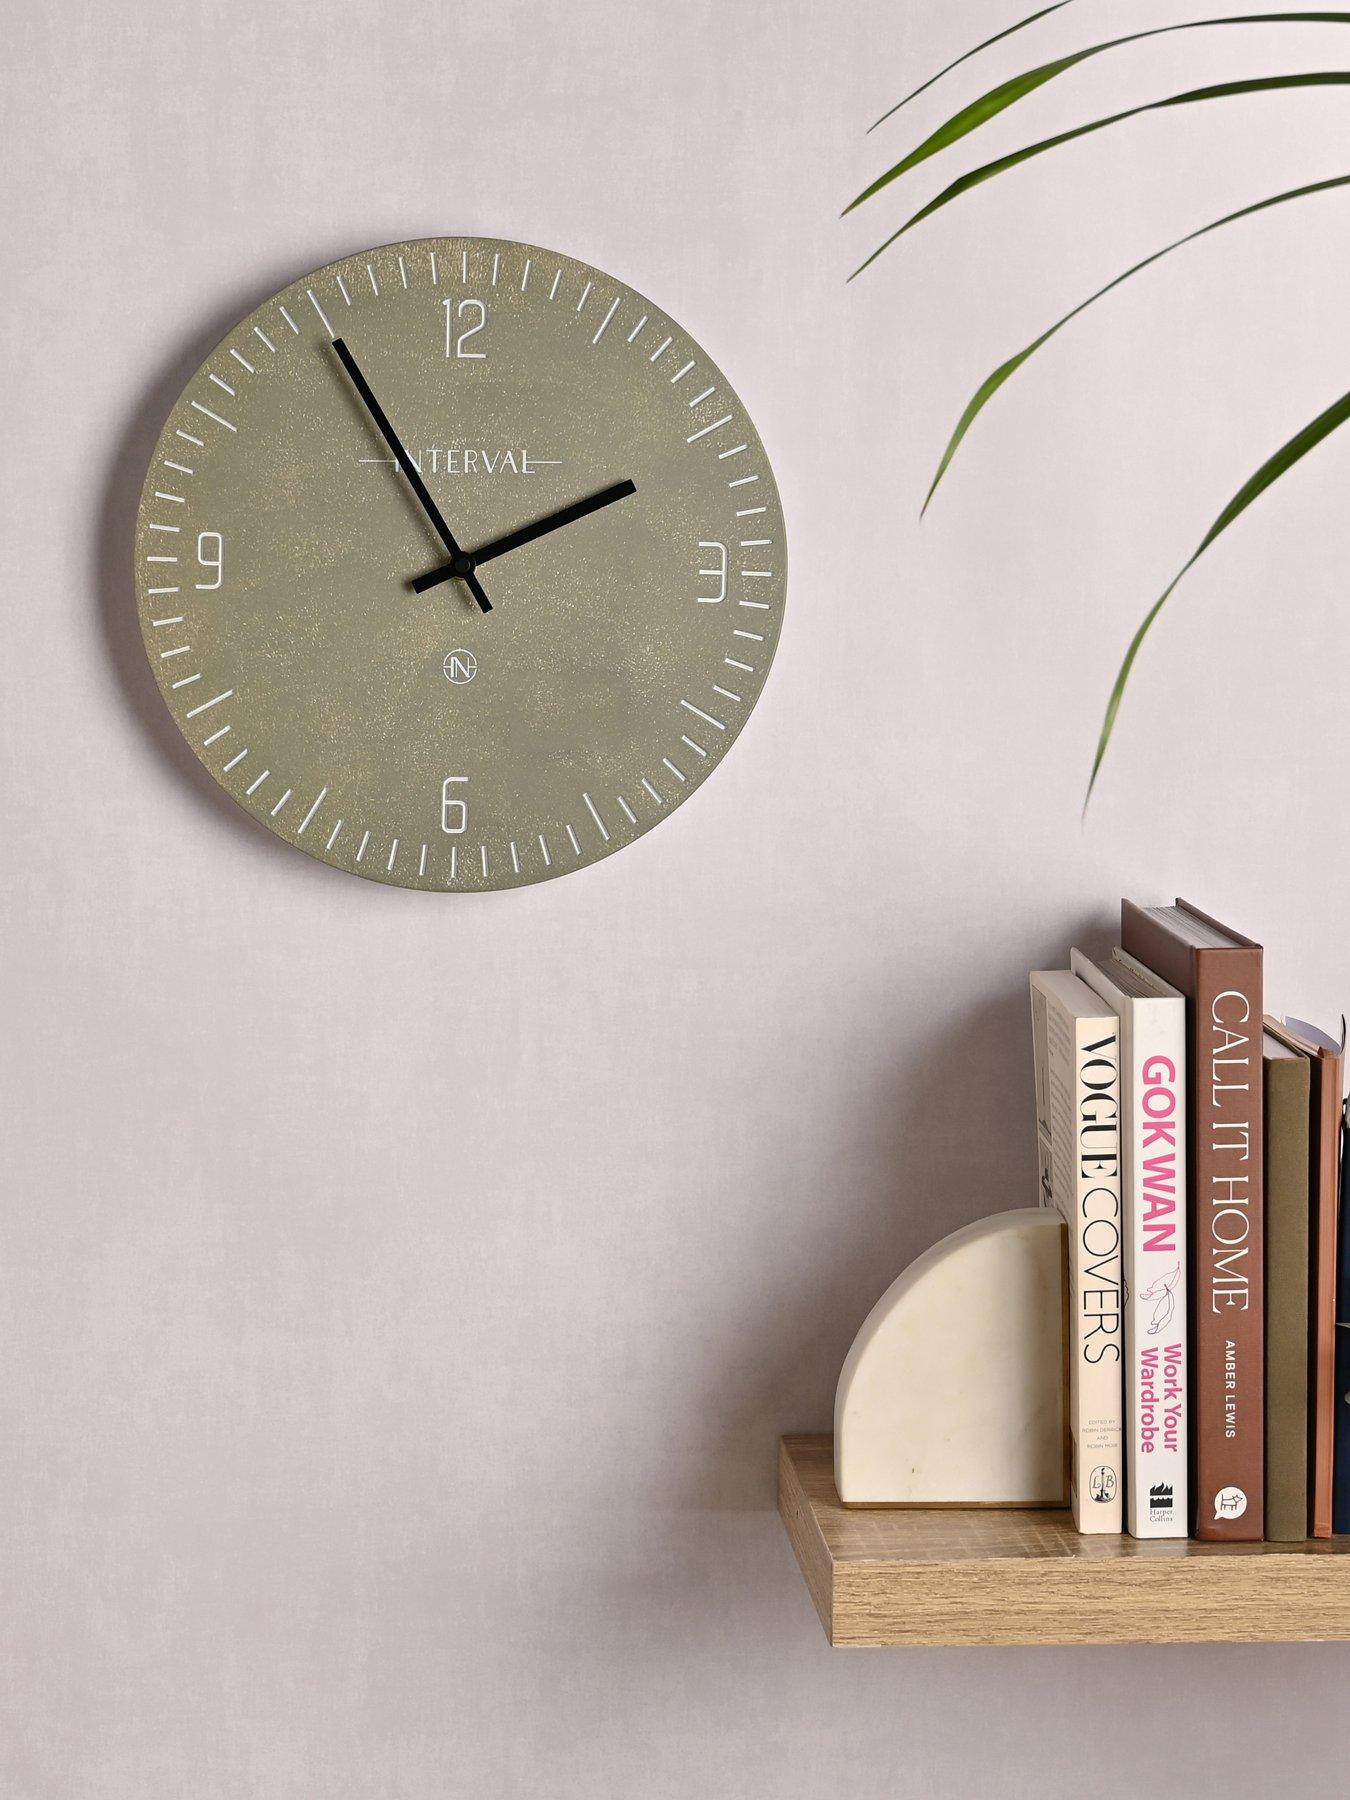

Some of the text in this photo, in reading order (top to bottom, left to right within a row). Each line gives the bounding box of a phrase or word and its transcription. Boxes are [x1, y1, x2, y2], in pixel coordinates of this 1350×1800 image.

[442, 298, 488, 359] 12
[195, 532, 222, 590] 9
[697, 541, 728, 603] 3
[441, 777, 469, 834] 6
[1079, 1032, 1121, 1365] VOGUE COVERS
[1141, 1055, 1177, 1252] GOK WAN
[1211, 990, 1250, 1315] CALL IT HOME
[1140, 1346, 1160, 1454] Wardrobe
[1163, 1342, 1183, 1453] Work Your
[1224, 1340, 1236, 1439] AMBER LEWIS
